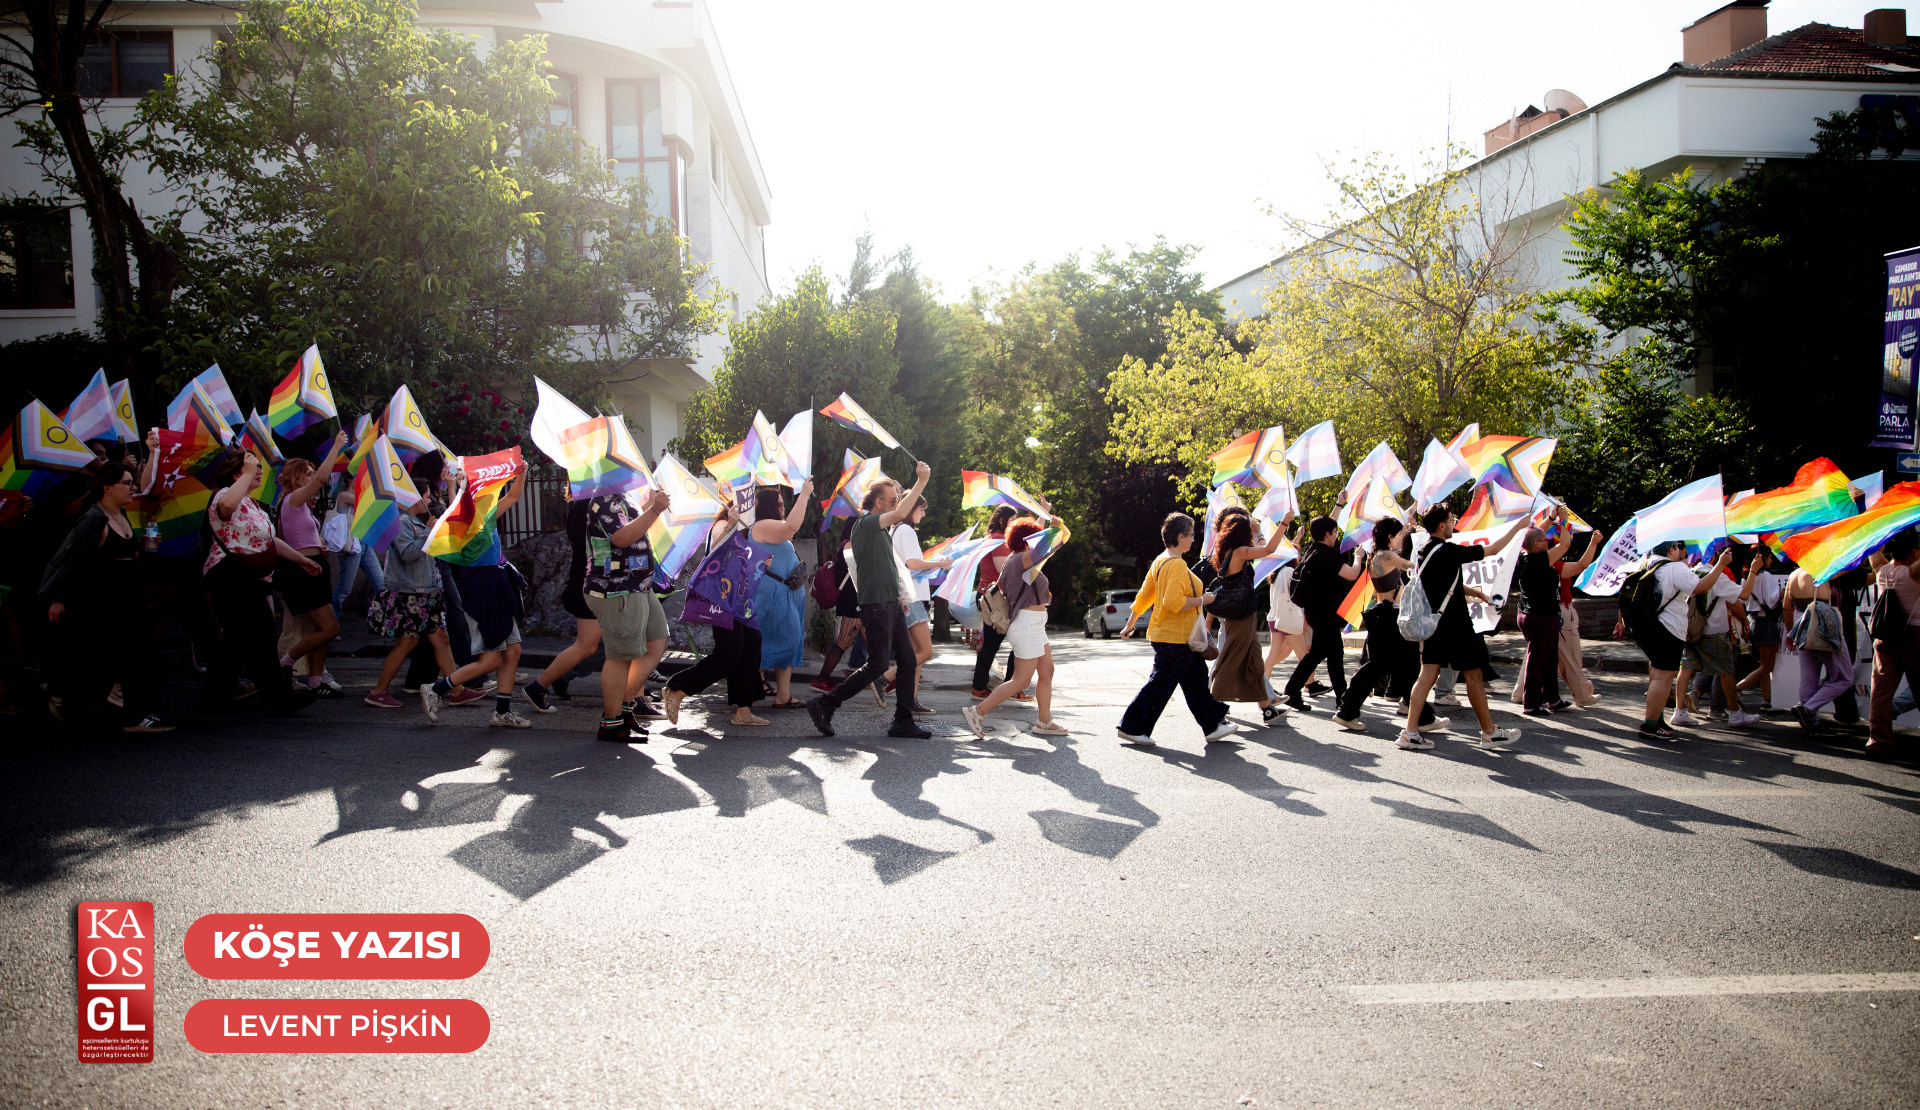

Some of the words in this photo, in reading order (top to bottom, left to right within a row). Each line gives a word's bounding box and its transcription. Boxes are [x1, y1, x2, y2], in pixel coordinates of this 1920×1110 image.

[1895, 262, 1917, 273] GAMADOR
[1889, 275, 1903, 284] PARLA
[1880, 415, 1910, 427] PARLA
